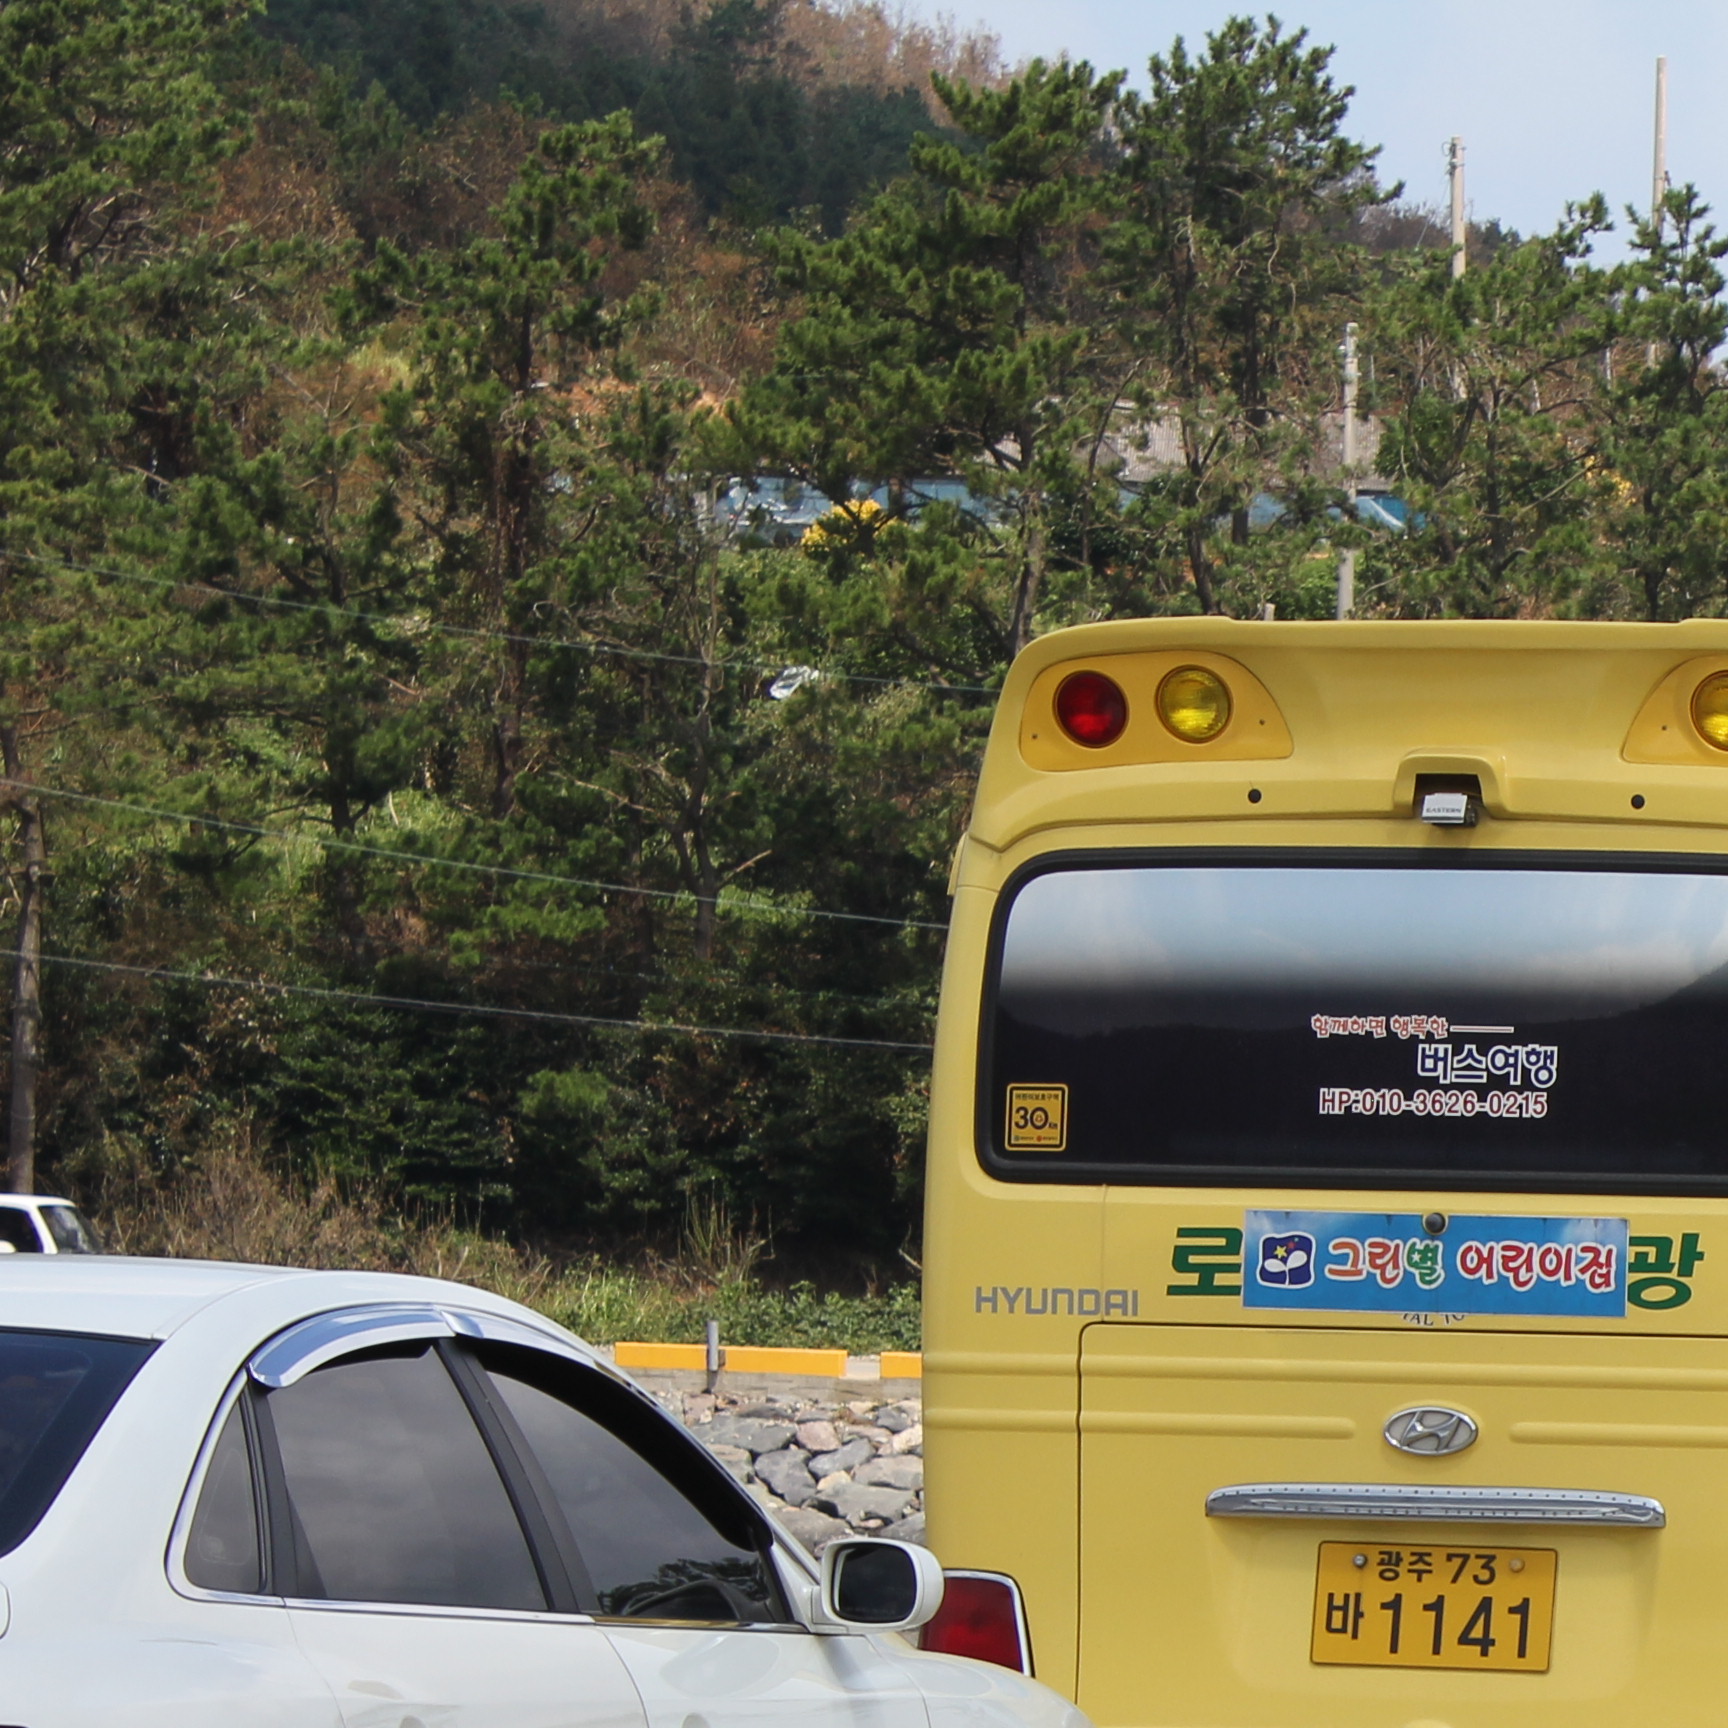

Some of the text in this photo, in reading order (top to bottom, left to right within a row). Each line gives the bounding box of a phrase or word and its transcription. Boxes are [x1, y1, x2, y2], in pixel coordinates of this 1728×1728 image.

[1311, 1014, 1449, 1039] 함께하면 행복한
[1417, 1044, 1558, 1088] 버스여행
[1319, 1088, 1549, 1118] HP:010-3626-0215
[1325, 1239, 1616, 1294] 그린별 어린이집
[975, 1286, 1138, 1317] HYUNDAI
[1377, 1551, 1497, 1585] 광주 73
